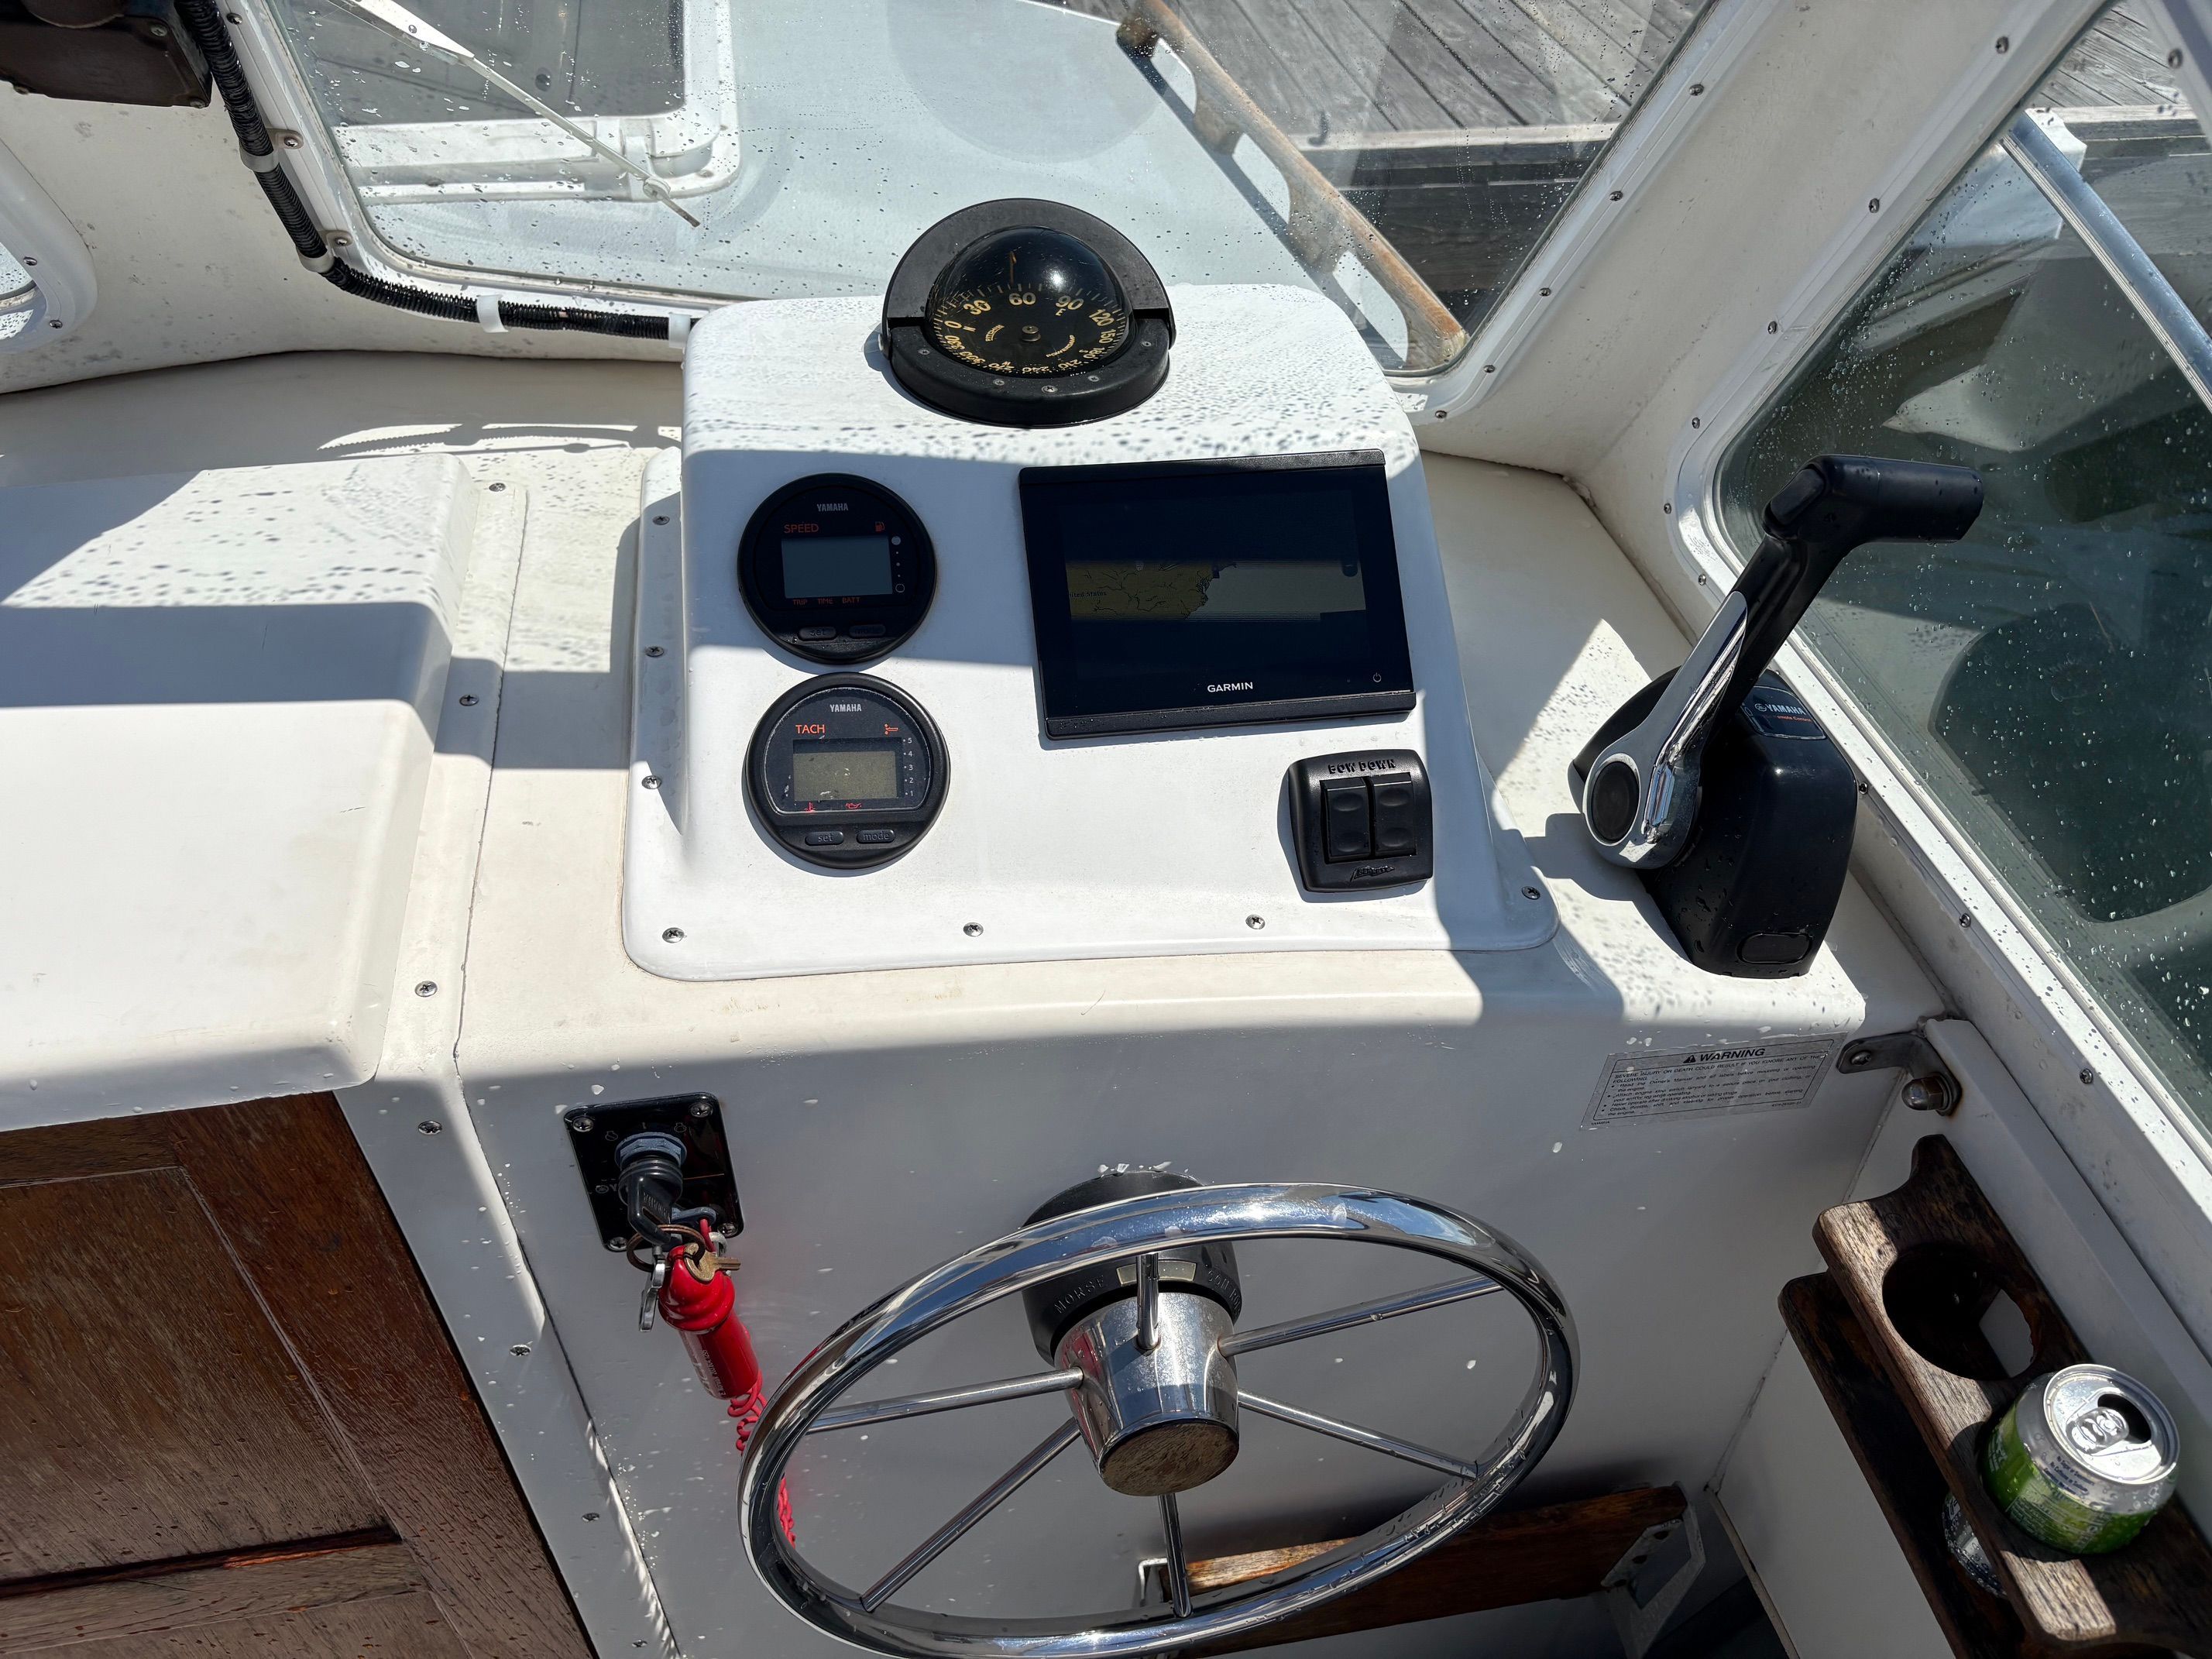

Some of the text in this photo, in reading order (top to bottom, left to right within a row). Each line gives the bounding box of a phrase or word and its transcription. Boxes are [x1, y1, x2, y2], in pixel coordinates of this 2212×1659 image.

[1008, 292, 1036, 306] 60
[1055, 295, 1084, 311] 90
[963, 300, 991, 315] 30
[1088, 309, 1115, 326] 120
[1098, 328, 1117, 344] 150
[944, 335, 966, 350] 330
[959, 351, 986, 365] 300
[1083, 347, 1105, 359] 180
[1057, 359, 1082, 369] 210
[816, 503, 849, 512] YAMAHA
[784, 523, 819, 534] SPEED
[1207, 682, 1253, 693] GARMIN
[830, 703, 862, 713] YAMAHA
[1765, 703, 1807, 715] YAMAHA
[795, 724, 826, 734] TACH
[1358, 758, 1396, 771] DOWN
[818, 833, 833, 842] set
[863, 830, 890, 841] mode
[1699, 1048, 1766, 1062] WARNING
[1053, 1274, 1105, 1314] MORSE
